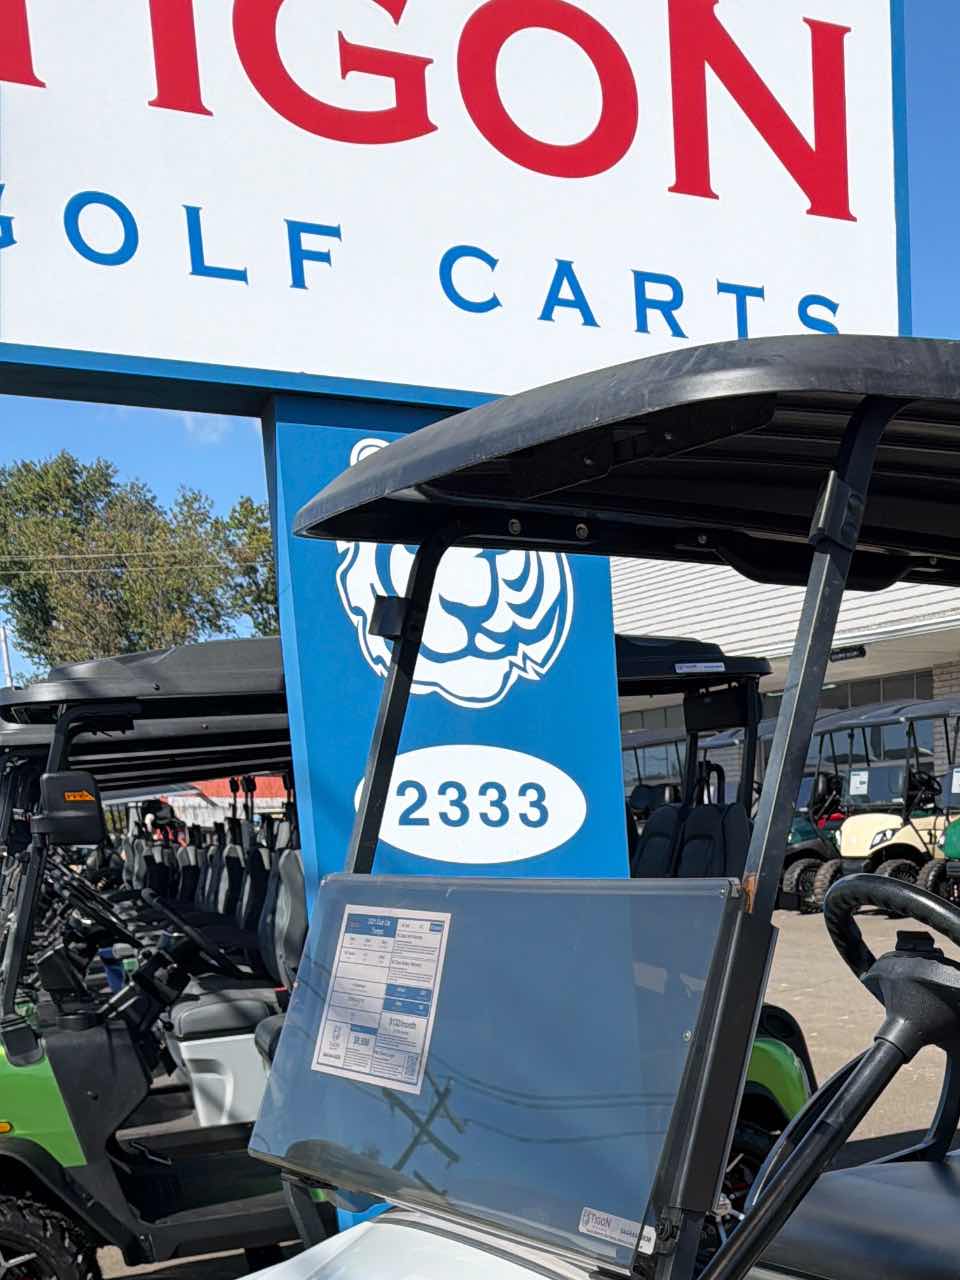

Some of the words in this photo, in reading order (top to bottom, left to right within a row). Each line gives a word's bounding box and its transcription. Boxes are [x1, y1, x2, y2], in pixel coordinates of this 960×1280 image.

[0, 184, 342, 290] OLF
[438, 245, 840, 340] CARTS
[395, 779, 549, 828] 2333
